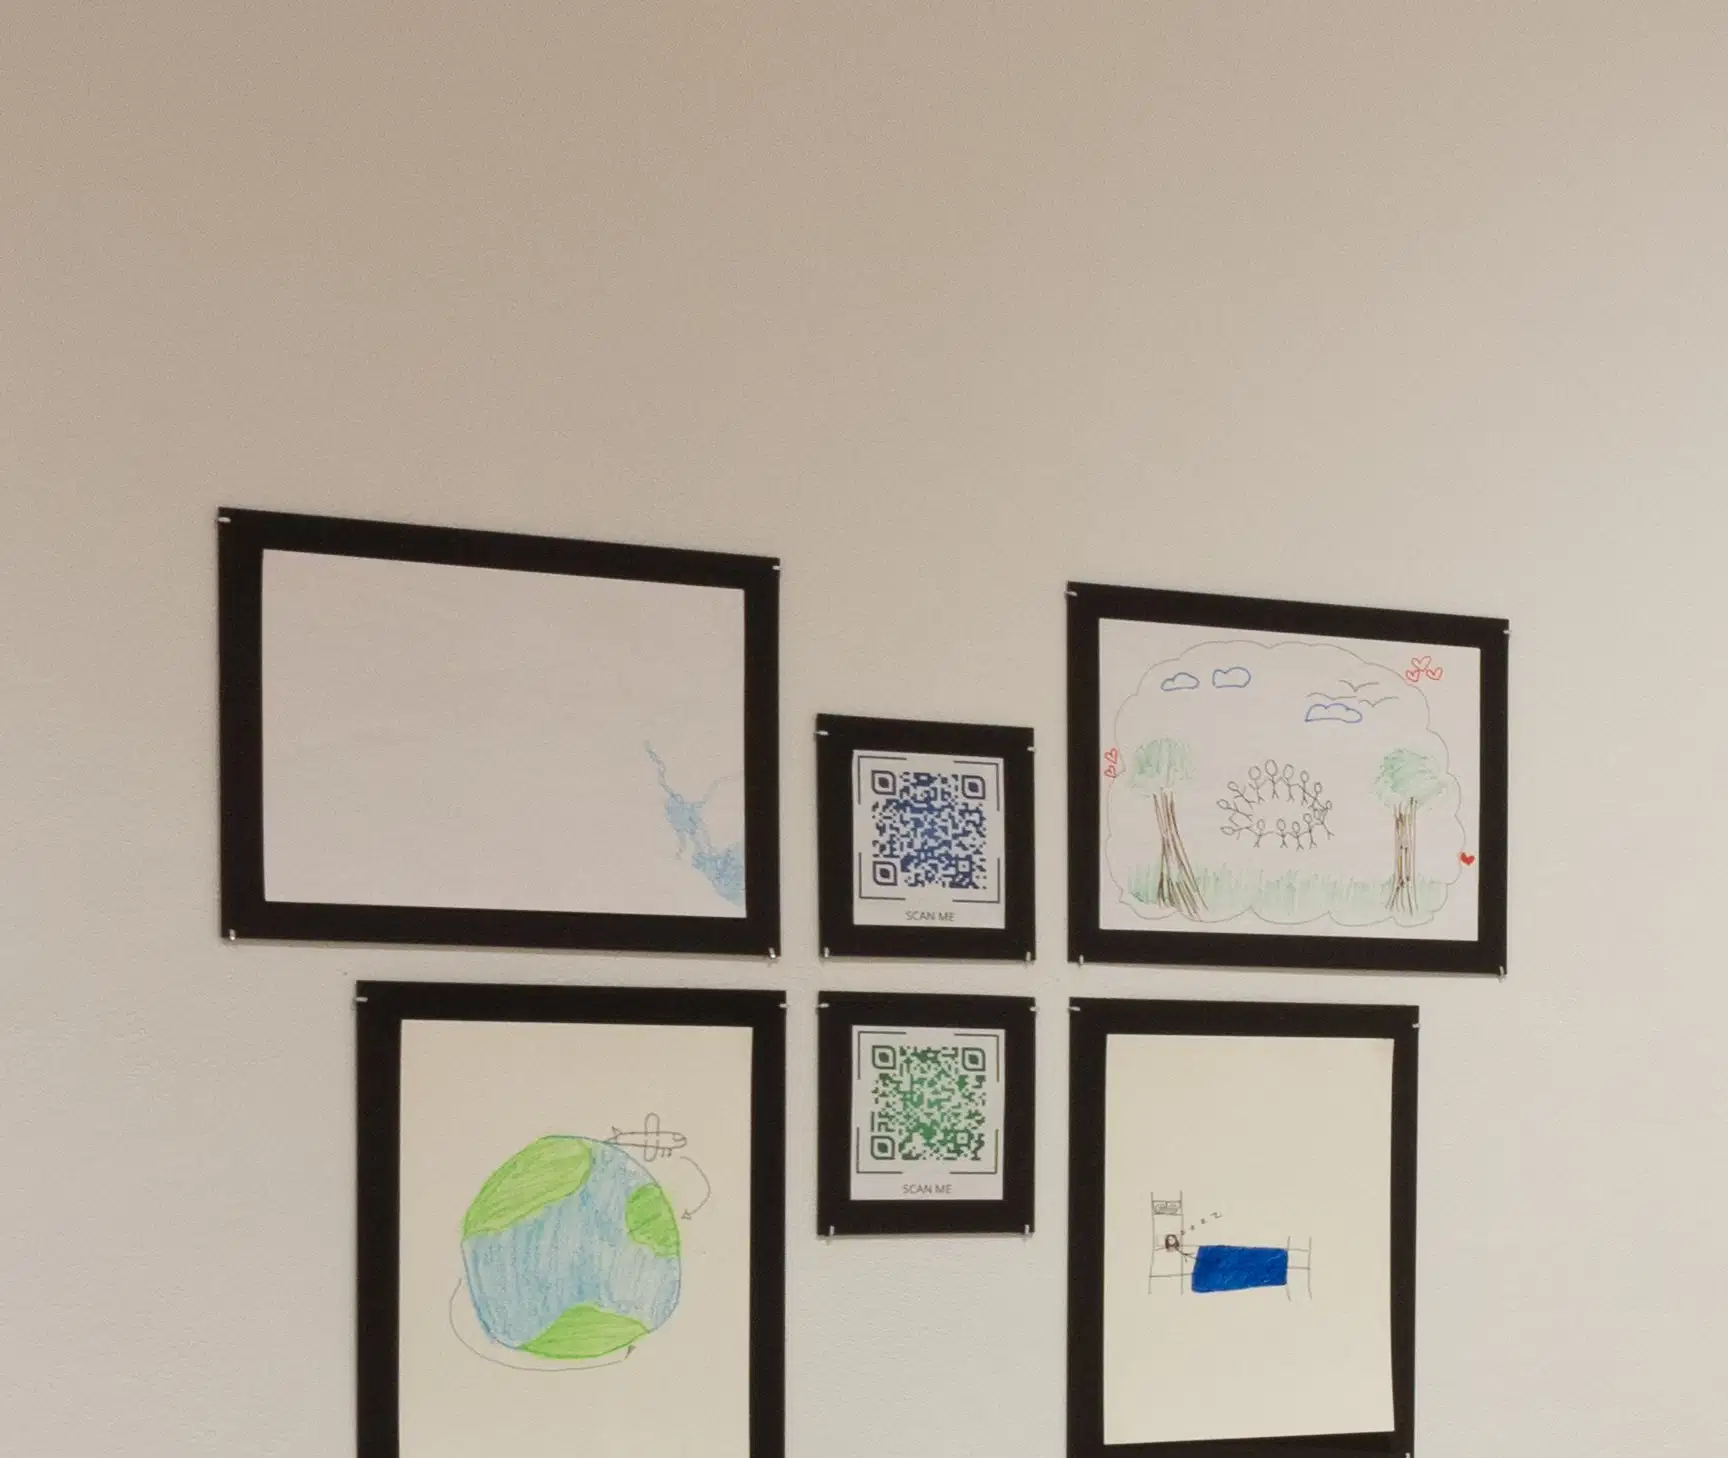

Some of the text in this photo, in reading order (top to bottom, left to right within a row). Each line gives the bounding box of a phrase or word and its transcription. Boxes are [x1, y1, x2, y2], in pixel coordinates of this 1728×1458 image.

[905, 910, 956, 922] SCAN ME
[903, 1183, 952, 1194] SCAN ME
